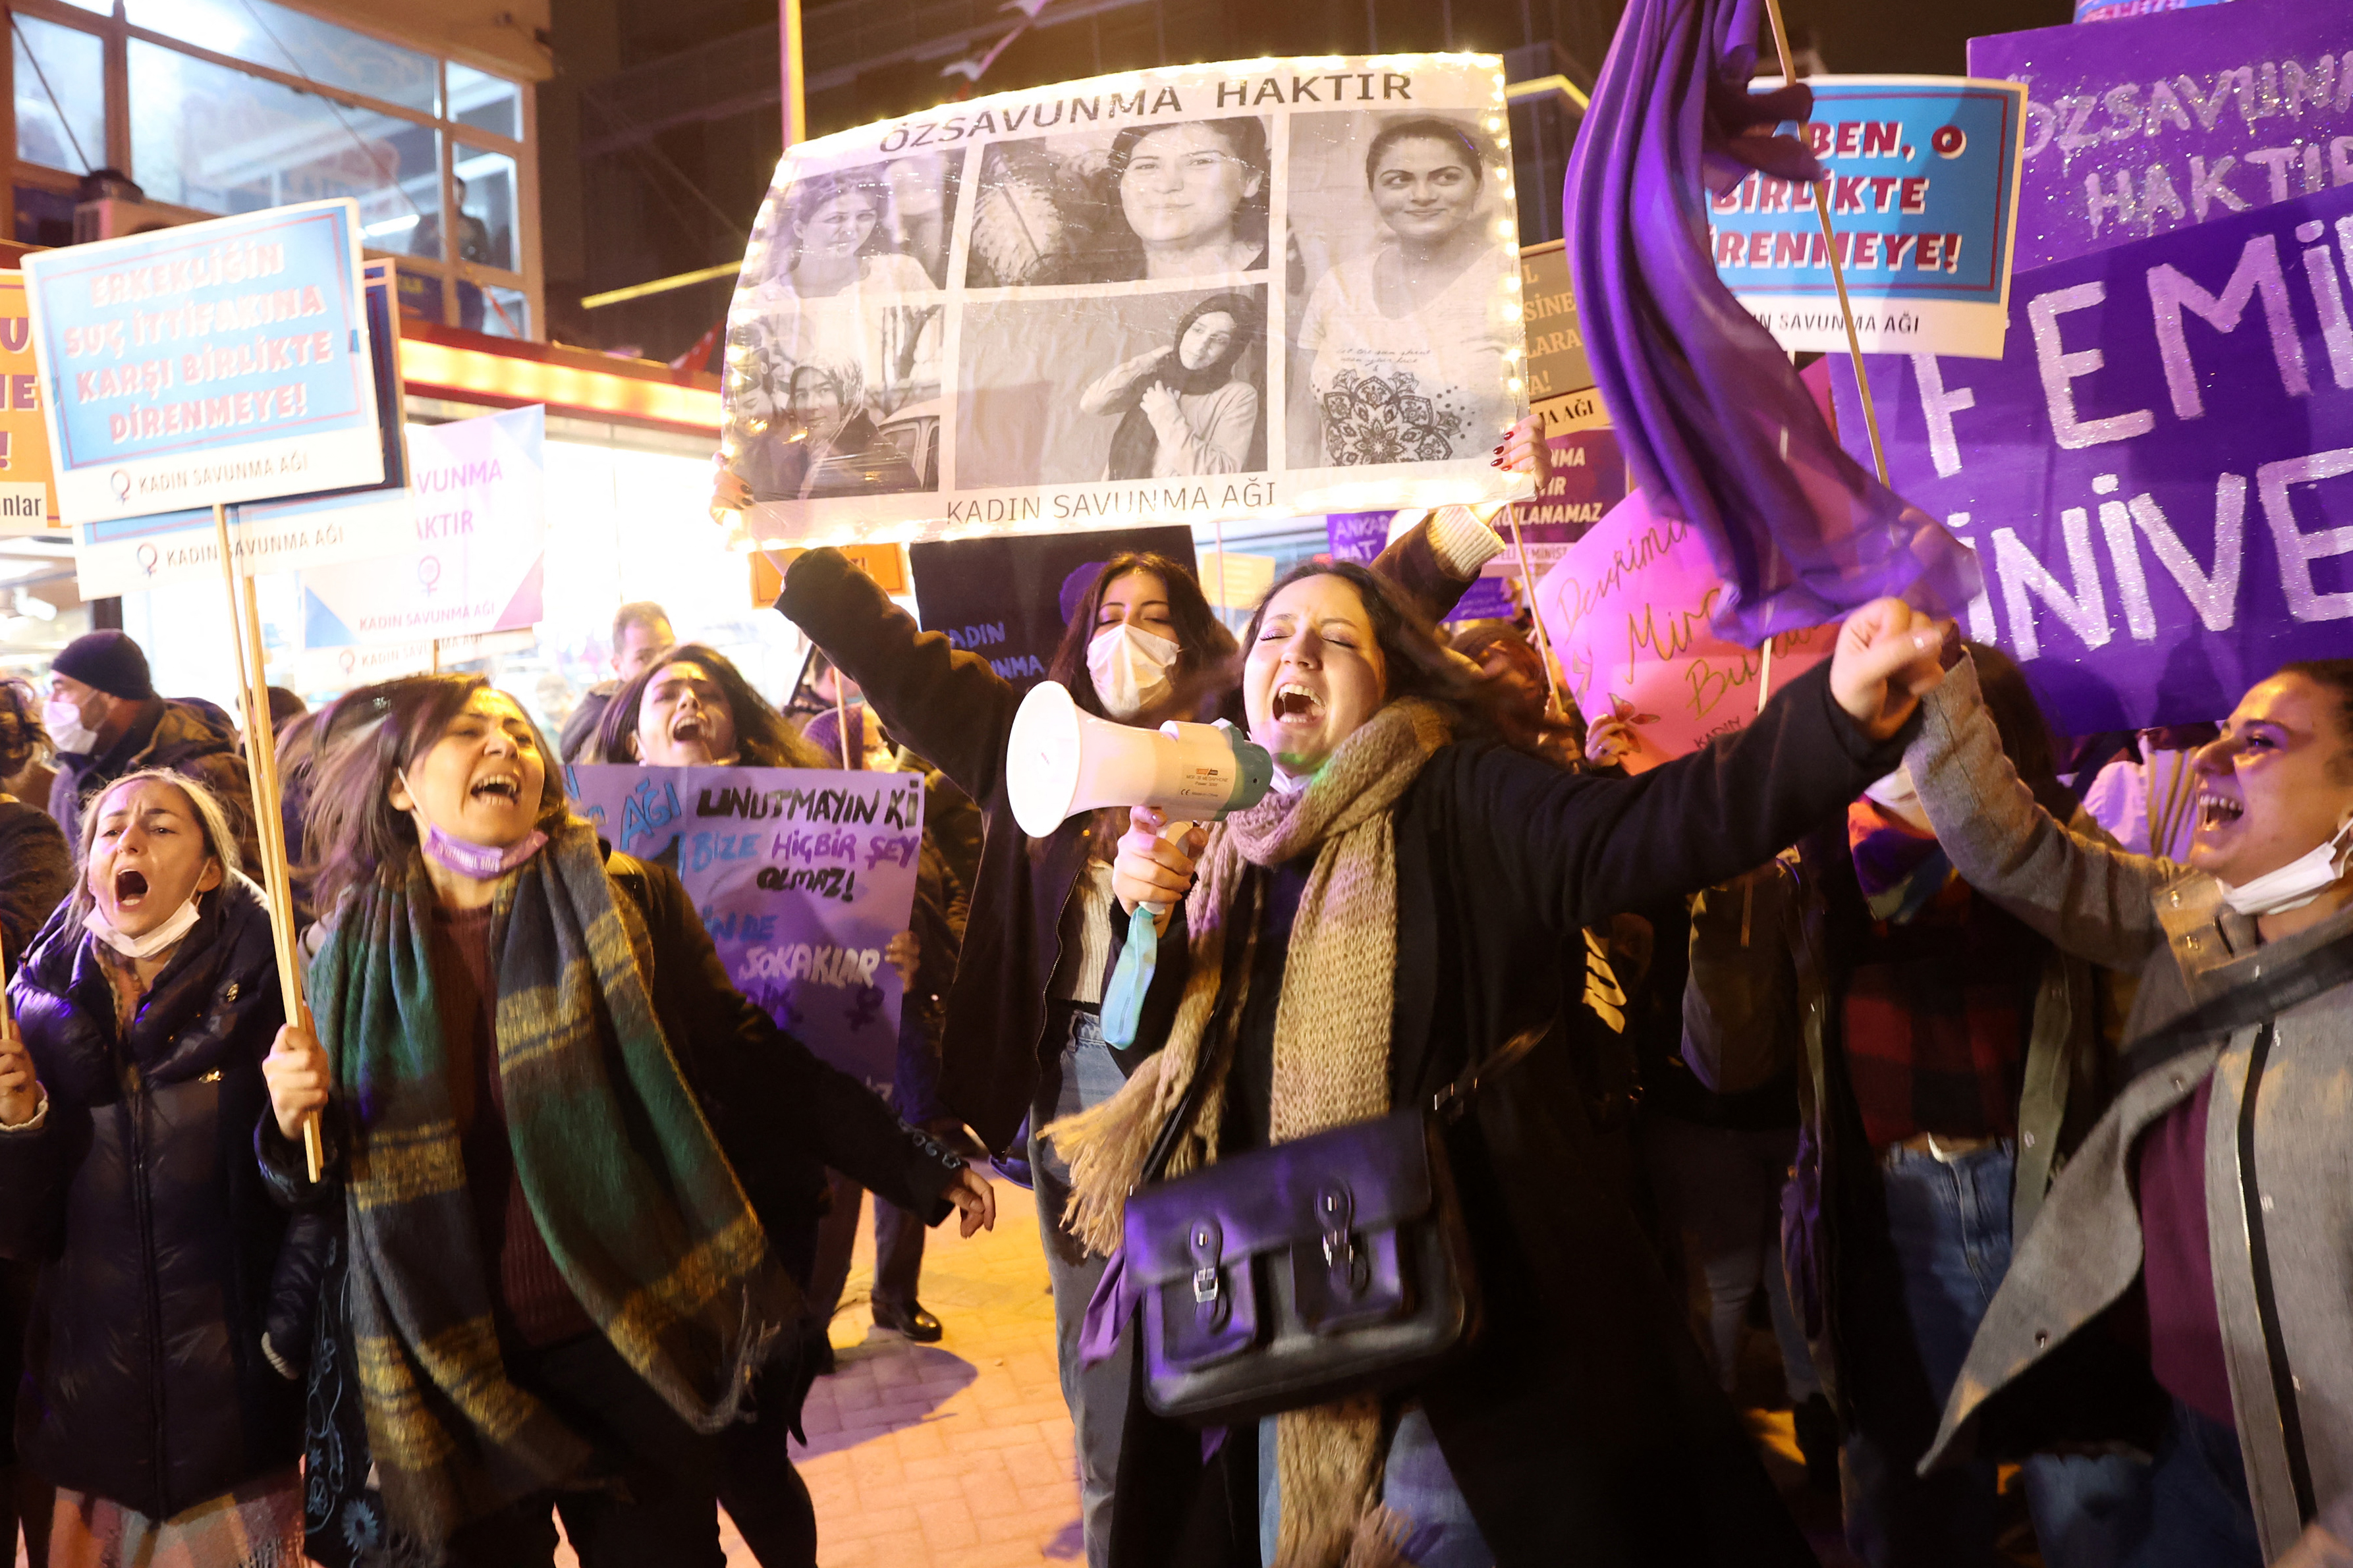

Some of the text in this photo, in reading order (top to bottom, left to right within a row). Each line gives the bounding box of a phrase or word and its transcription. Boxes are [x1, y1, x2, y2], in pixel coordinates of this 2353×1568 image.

[879, 72, 1412, 153] ÖZSAVUNMA HAKTIR
[1931, 125, 1967, 159] O
[90, 241, 285, 308] ERKEKLİĞİN
[64, 284, 327, 359] SUÇ İTTİFAKINA
[1883, 310, 1919, 335] AĞI
[1910, 212, 2353, 479] FEMİ
[76, 331, 334, 404] KARŞI BİRLİKTE
[109, 382, 308, 445] DİRENMEYE!
[1563, 398, 1595, 423] AĞI
[138, 450, 309, 494] KADIN SAVUNMA AĞI
[414, 458, 503, 497] VUNMA
[1539, 476, 1567, 497] IR
[0, 494, 42, 517] nlar
[947, 477, 1276, 524] KADIN SAVUNMA AĞI
[1491, 502, 1603, 528] LANAMAZ
[167, 523, 345, 566] KADIN AVUNMA AĞI
[359, 599, 495, 632] KADIN SAVUNMA AĞI
[942, 621, 1006, 649] ADIN
[696, 780, 919, 830] UNUTMAYIN Kİ
[771, 827, 856, 864] HİÇBİR
[864, 835, 919, 870] ŞEY
[757, 866, 855, 902] OLMAZ!
[738, 942, 880, 988] SOKAKLAR
